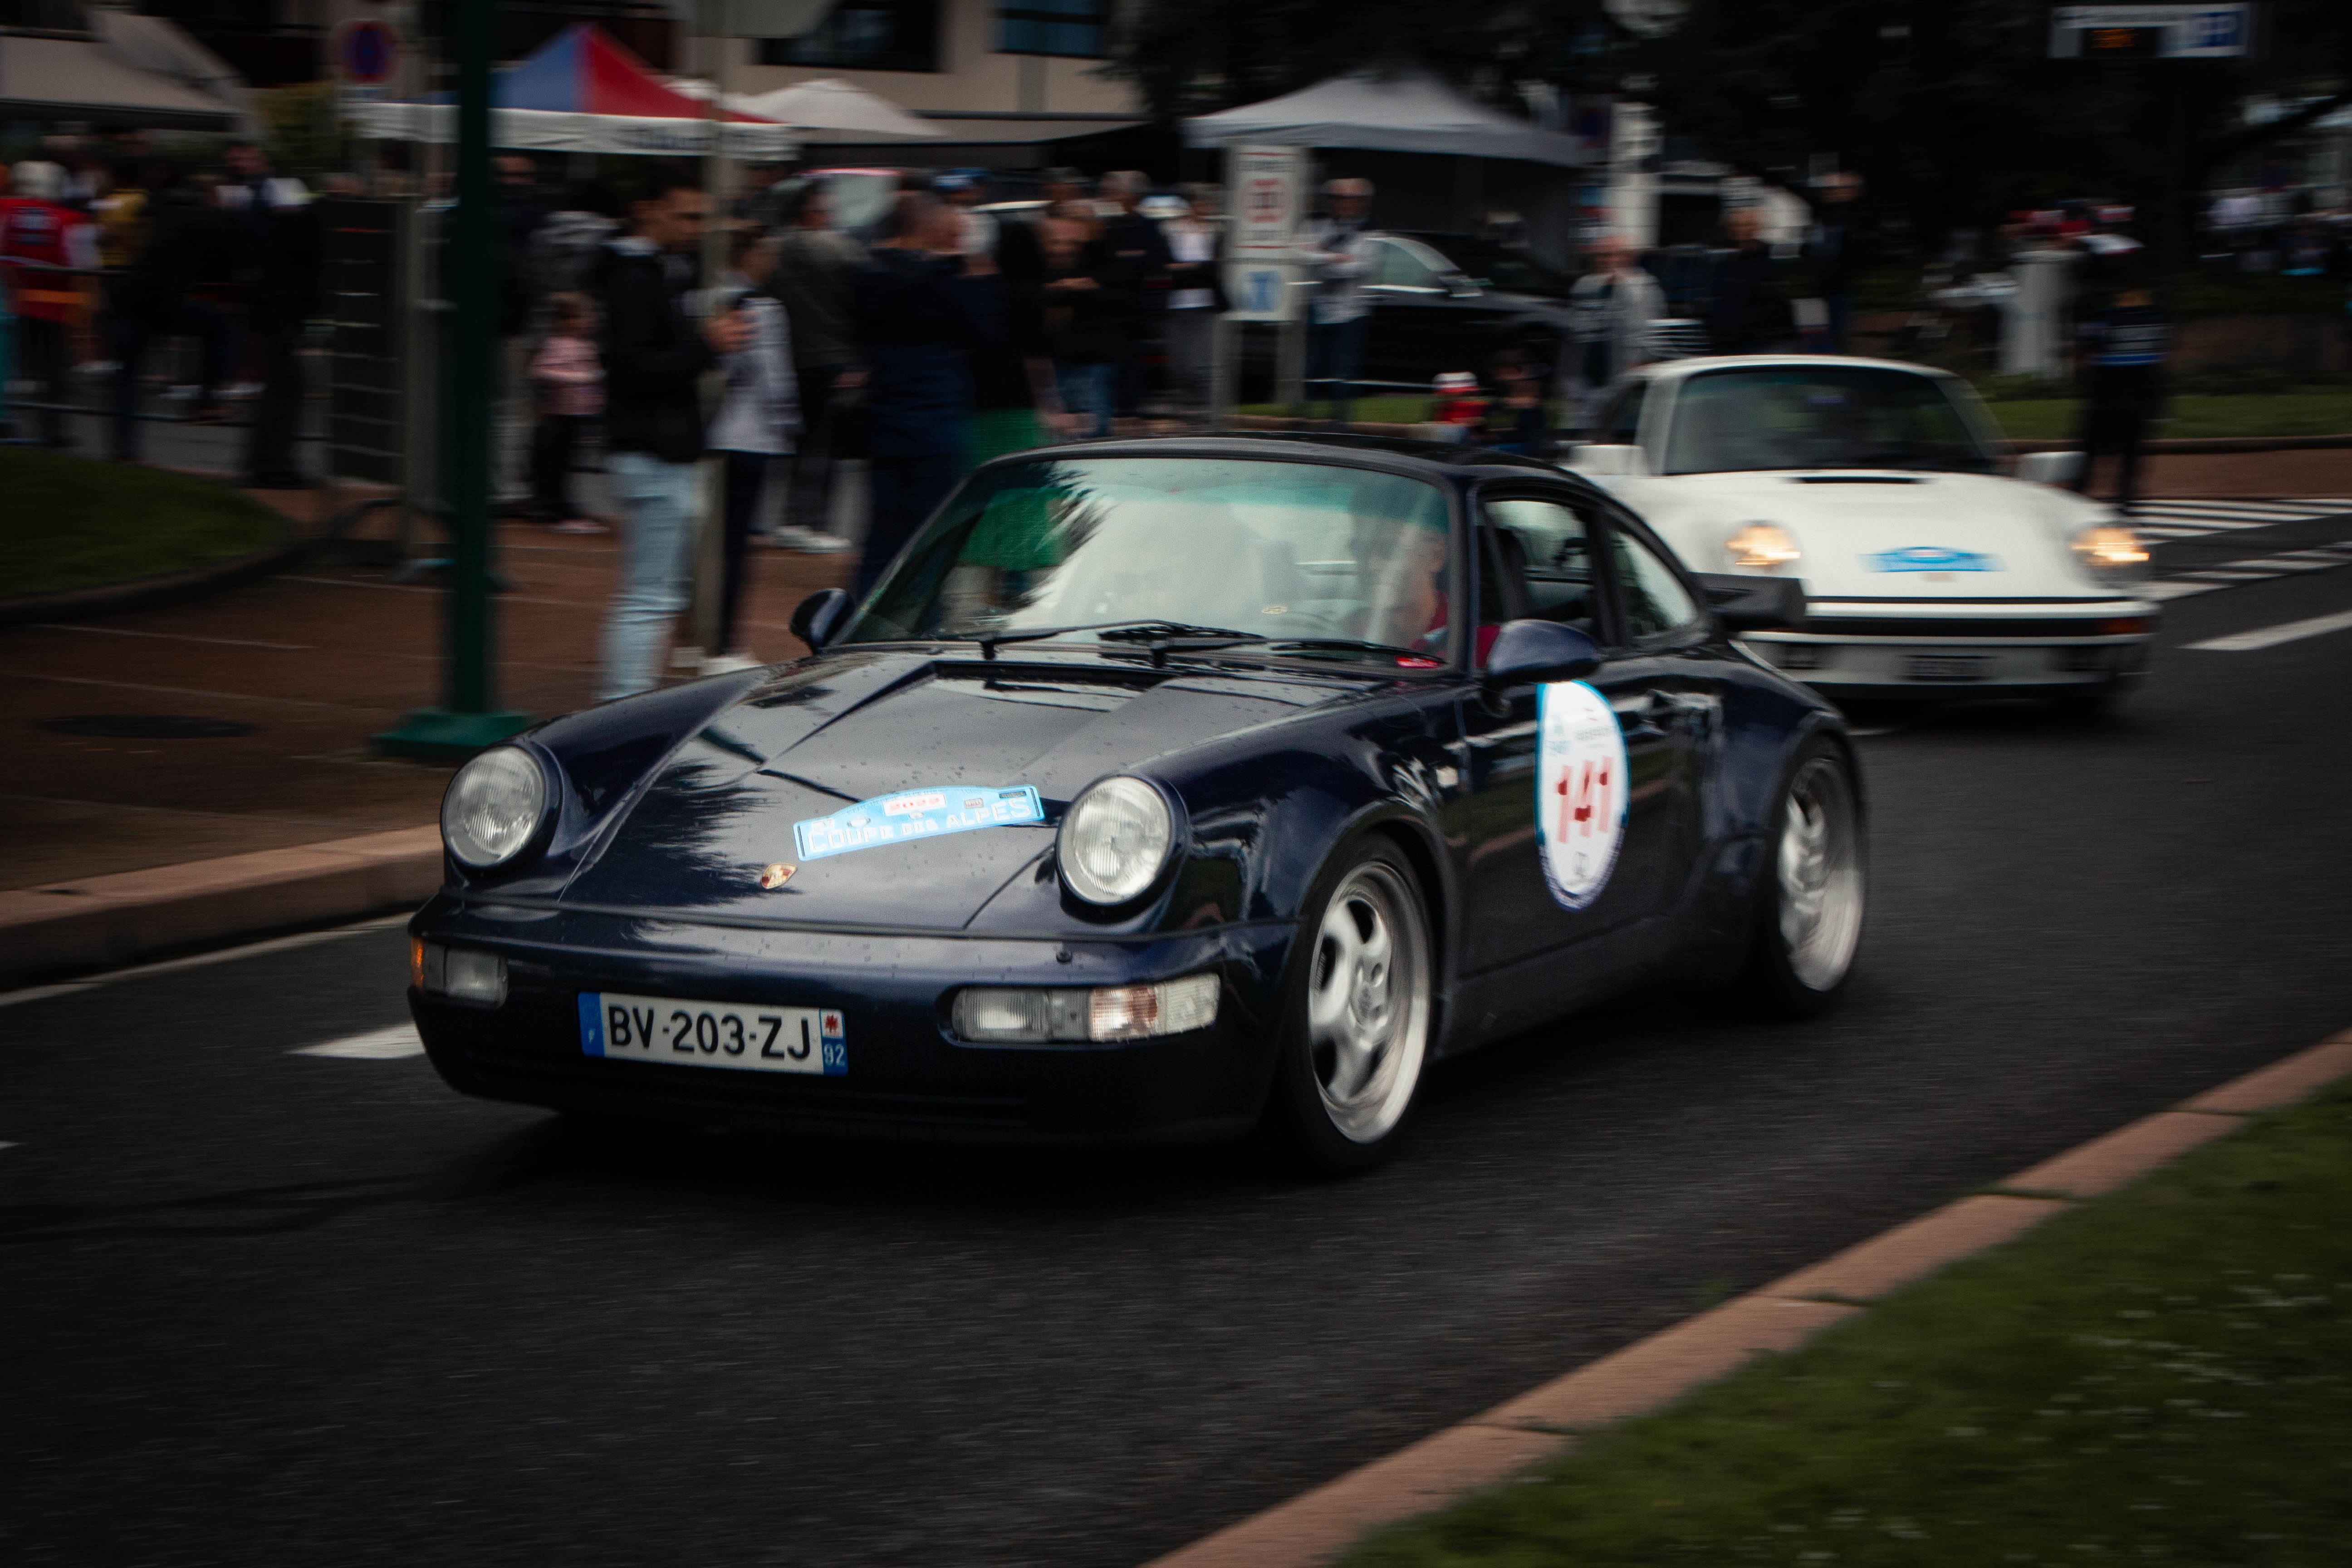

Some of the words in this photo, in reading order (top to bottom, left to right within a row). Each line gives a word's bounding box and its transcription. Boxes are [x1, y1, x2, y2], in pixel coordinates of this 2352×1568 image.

[808, 825, 894, 852] COUPE
[902, 818, 938, 835] DES
[946, 797, 1032, 828] ALPES
[1553, 756, 1614, 844] 141
[608, 1005, 811, 1060] BV-203-ZJ
